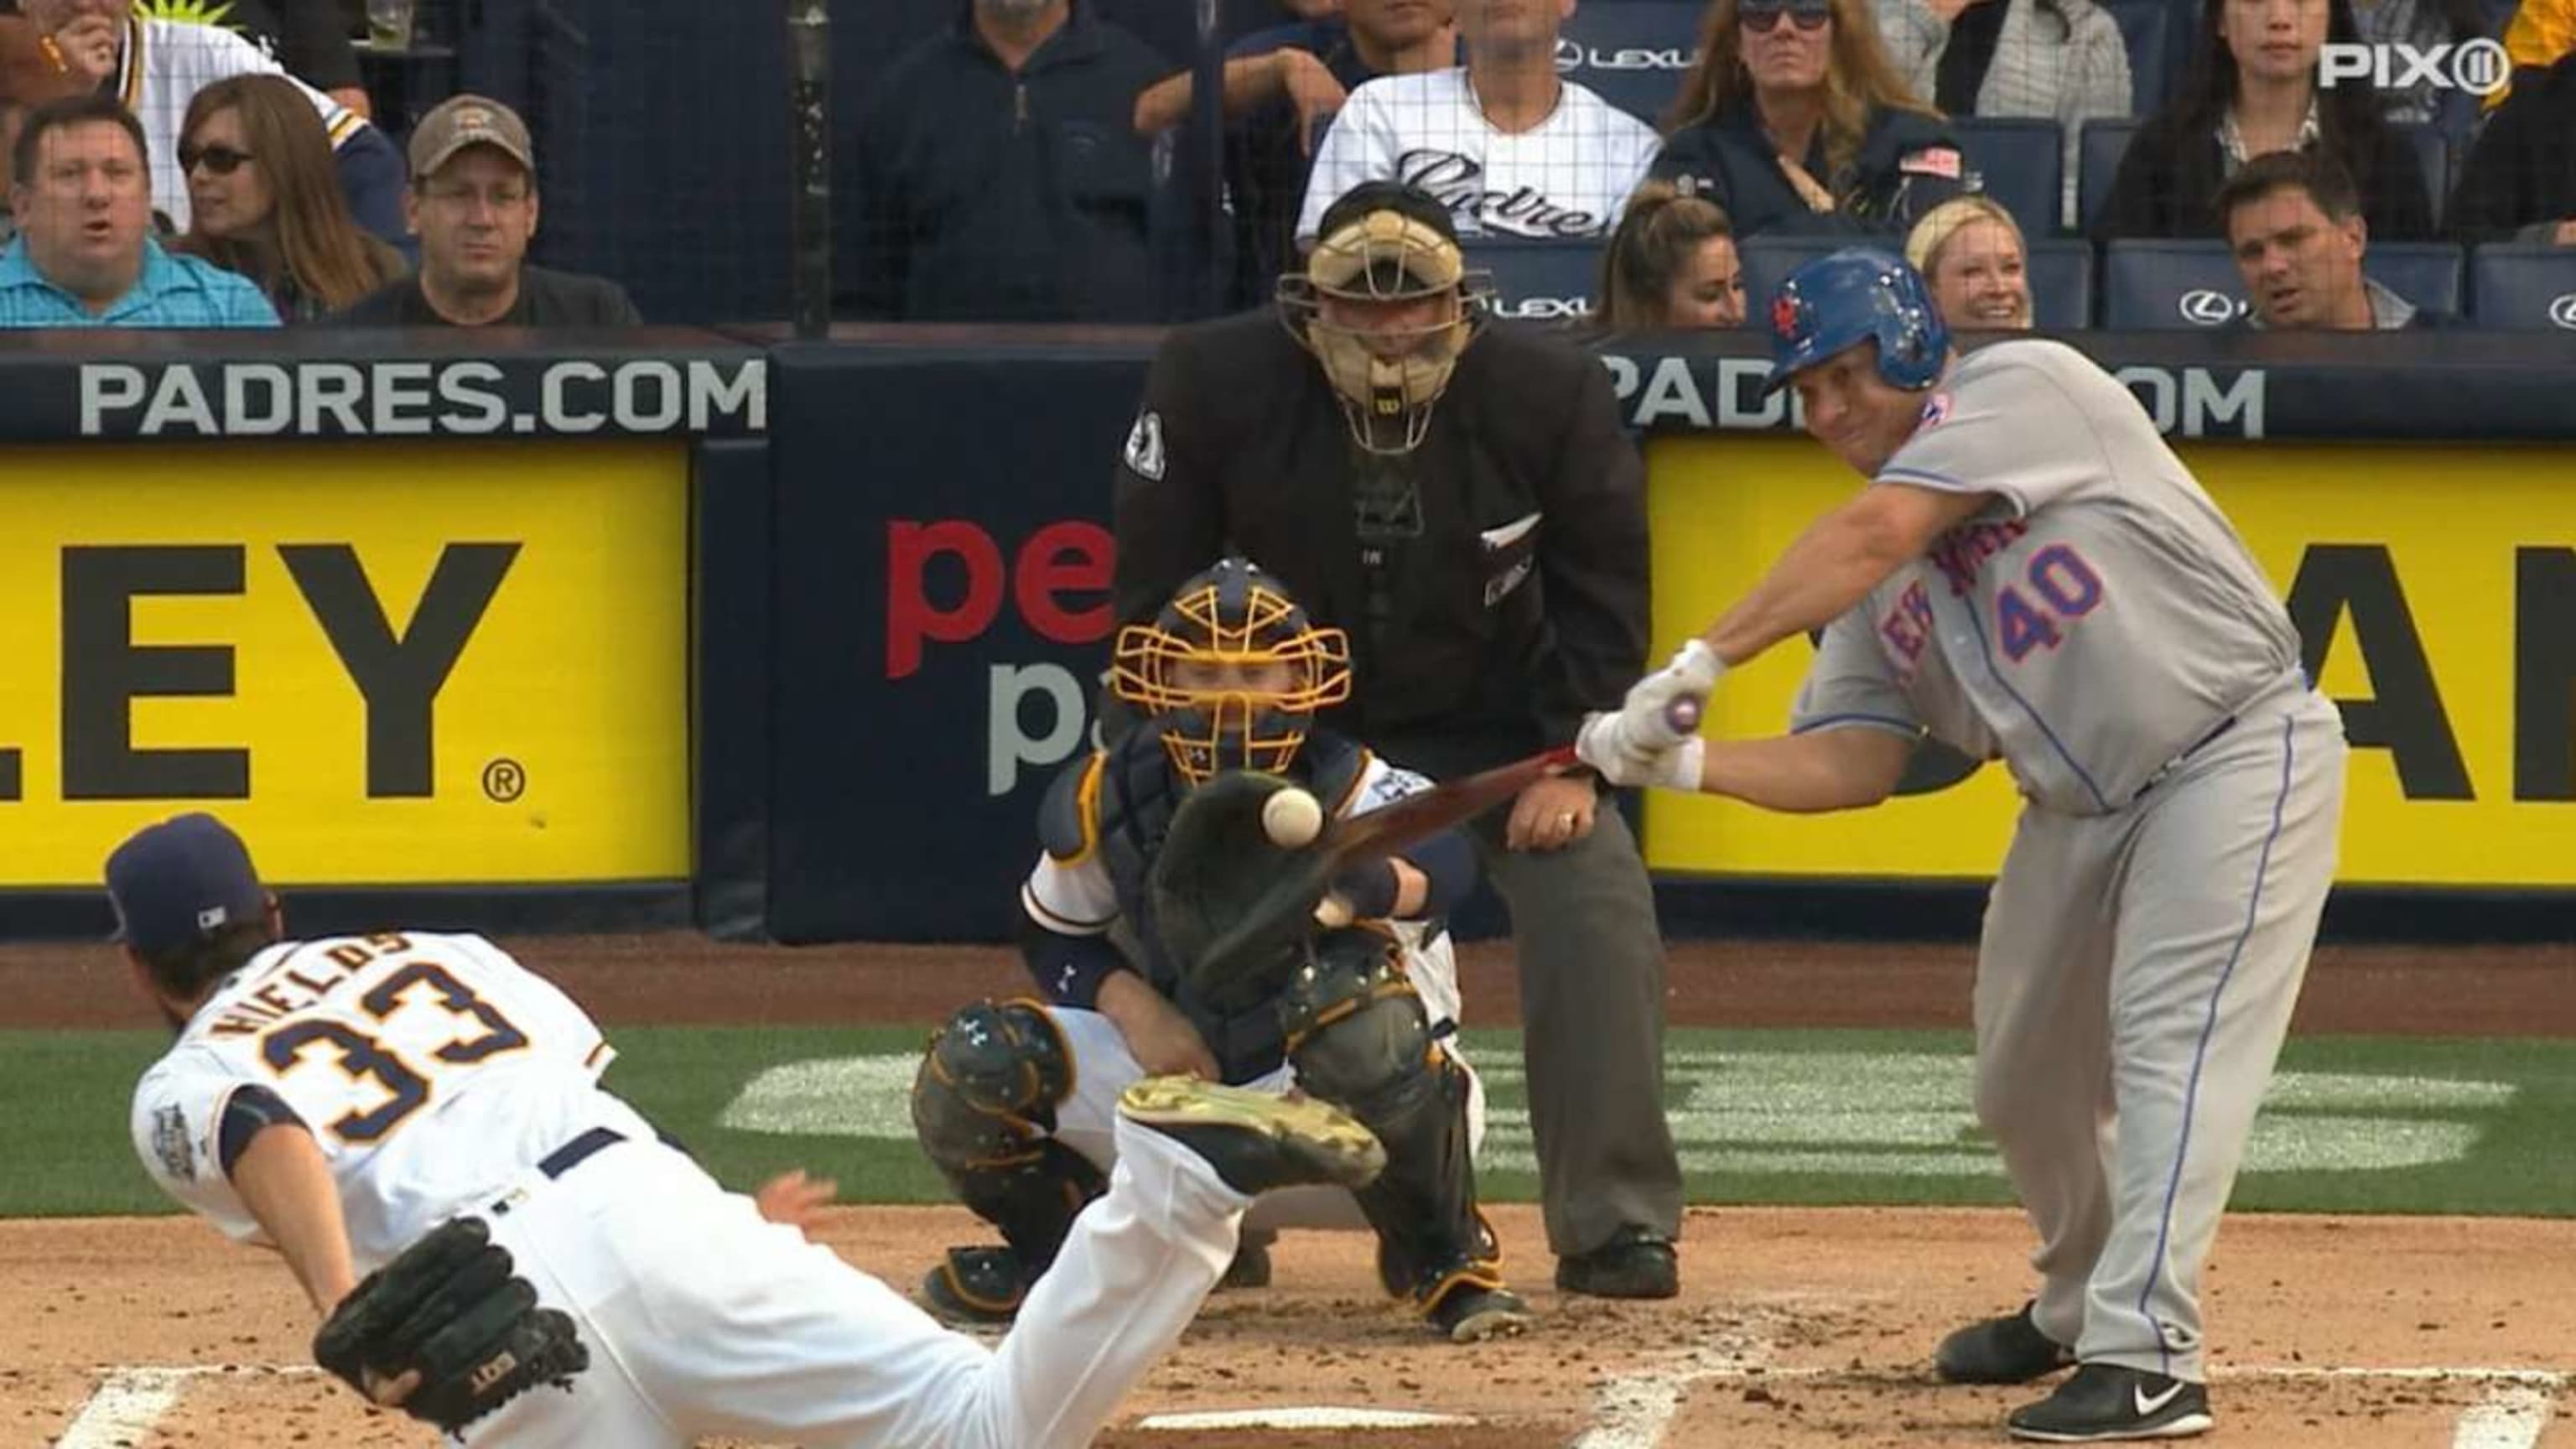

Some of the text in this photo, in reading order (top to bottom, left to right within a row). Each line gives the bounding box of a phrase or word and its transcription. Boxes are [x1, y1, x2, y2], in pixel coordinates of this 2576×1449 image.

[80, 360, 767, 435] PADRES.COM
[1995, 540, 2103, 665] 40
[257, 960, 531, 1143] 33
